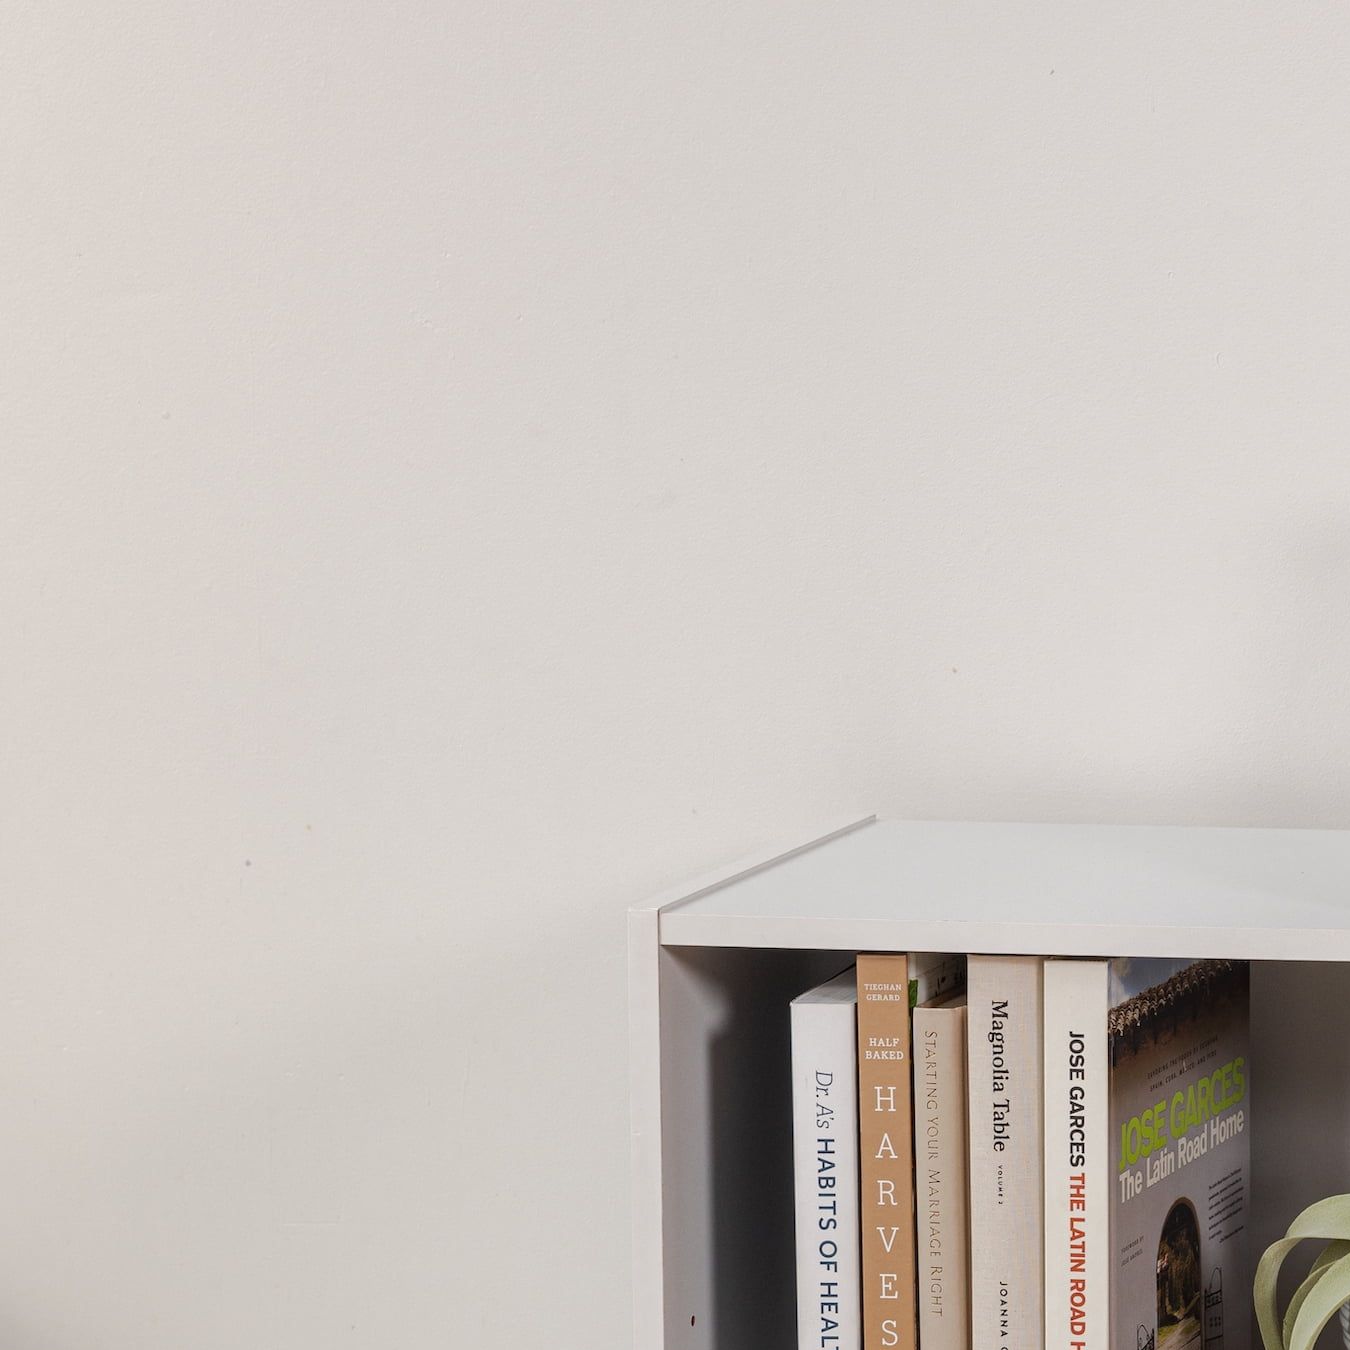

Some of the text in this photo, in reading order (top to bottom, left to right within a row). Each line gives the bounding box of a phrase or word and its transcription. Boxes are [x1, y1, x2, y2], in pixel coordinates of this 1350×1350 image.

[863, 983, 902, 991] TIEGHAN
[865, 1050, 904, 1060] BAKED
[868, 1037, 900, 1047] HALF
[1069, 1031, 1085, 1081] JOSE
[815, 1070, 833, 1098] Dr.
[988, 999, 1010, 1152] Magnolia Table
[816, 1103, 834, 1129] A's
[1069, 1086, 1085, 1167] GARCES
[1119, 1100, 1168, 1171] JOSE
[1169, 1056, 1247, 1139] GARCES
[817, 1138, 837, 1231] HABITS
[924, 1031, 943, 1317] STARTING YOUR MARRIAGE RIGHT
[1119, 1109, 1244, 1204] The Latin Road Home
[1069, 1172, 1086, 1212] THE
[819, 1240, 838, 1273] OF
[1070, 1217, 1086, 1273] LATIN
[1000, 1281, 1008, 1338] JOANNA
[1070, 1278, 1086, 1336] ROAD
